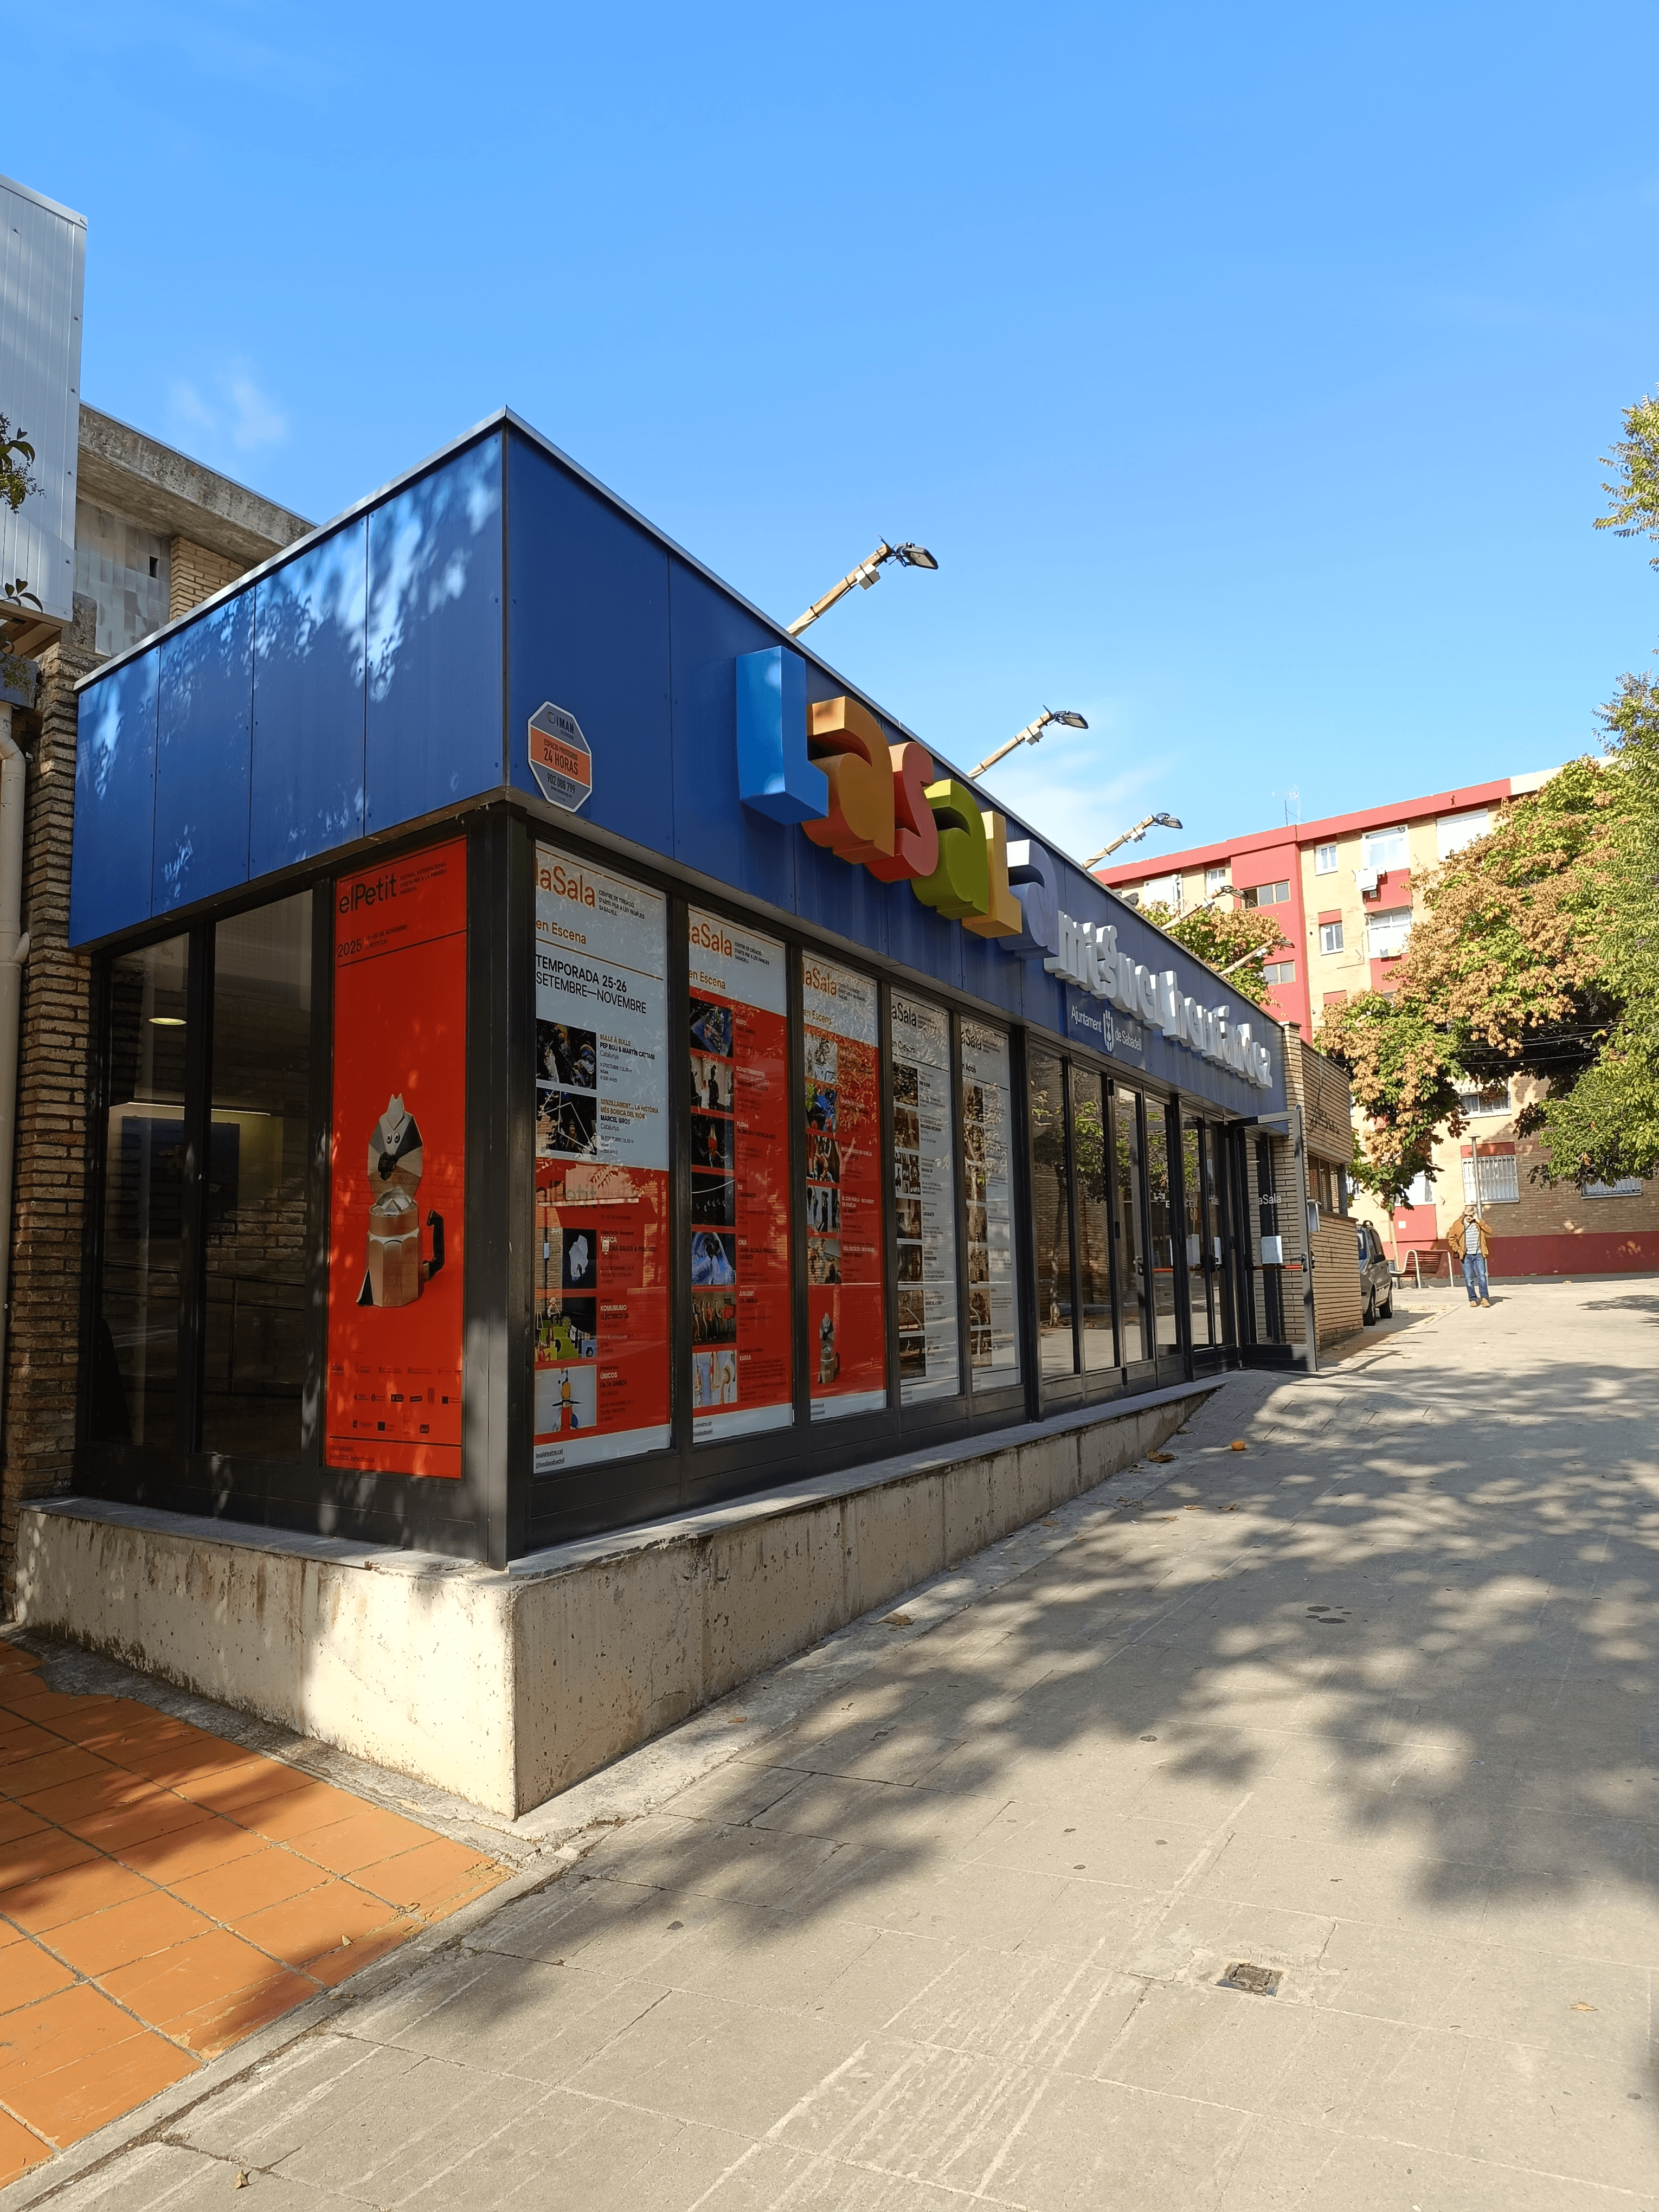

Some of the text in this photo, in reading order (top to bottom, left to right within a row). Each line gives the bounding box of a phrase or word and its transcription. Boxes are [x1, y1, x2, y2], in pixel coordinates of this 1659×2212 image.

[556, 715, 574, 734] IMAN
[544, 738, 558, 751] ESPACIO
[544, 747, 578, 775] 24 HORAS
[547, 773, 556, 786] 902
[567, 781, 576, 794] 799
[400, 861, 447, 880] FESTIVAL INTERNACIONAL
[339, 872, 397, 914] elPetit
[599, 890, 613, 900] CENTRE
[619, 897, 635, 908] CREACIÓ
[599, 897, 612, 906] D'ARTS
[599, 904, 617, 916] SABADELL
[385, 923, 408, 935] NOVEMBRE
[536, 919, 587, 944] en Escena
[337, 938, 362, 958] 2025
[735, 941, 745, 950] CENTRE
[750, 948, 762, 956] CREACIÓ
[536, 954, 627, 993] TEMPORADA 25-26
[689, 970, 725, 989] en Escena
[803, 1009, 832, 1025] en Escena
[892, 1002, 916, 1027] aSala
[1071, 1005, 1142, 1051] Ajuntament de Sabadell
[600, 1034, 613, 1042] BULLE
[618, 1038, 631, 1046] BULLE
[961, 1028, 982, 1051] aSala
[600, 1050, 619, 1060] Catalunya
[622, 1047, 638, 1056] MARTÍN
[638, 1051, 655, 1060] CATTANI
[965, 1063, 976, 1073] Acció
[600, 1115, 618, 1123] MARCEL
[600, 1123, 619, 1132] Catalunya
[600, 1371, 618, 1379] ÚNICOS
[535, 1448, 564, 1459] lasalateatre.cat
